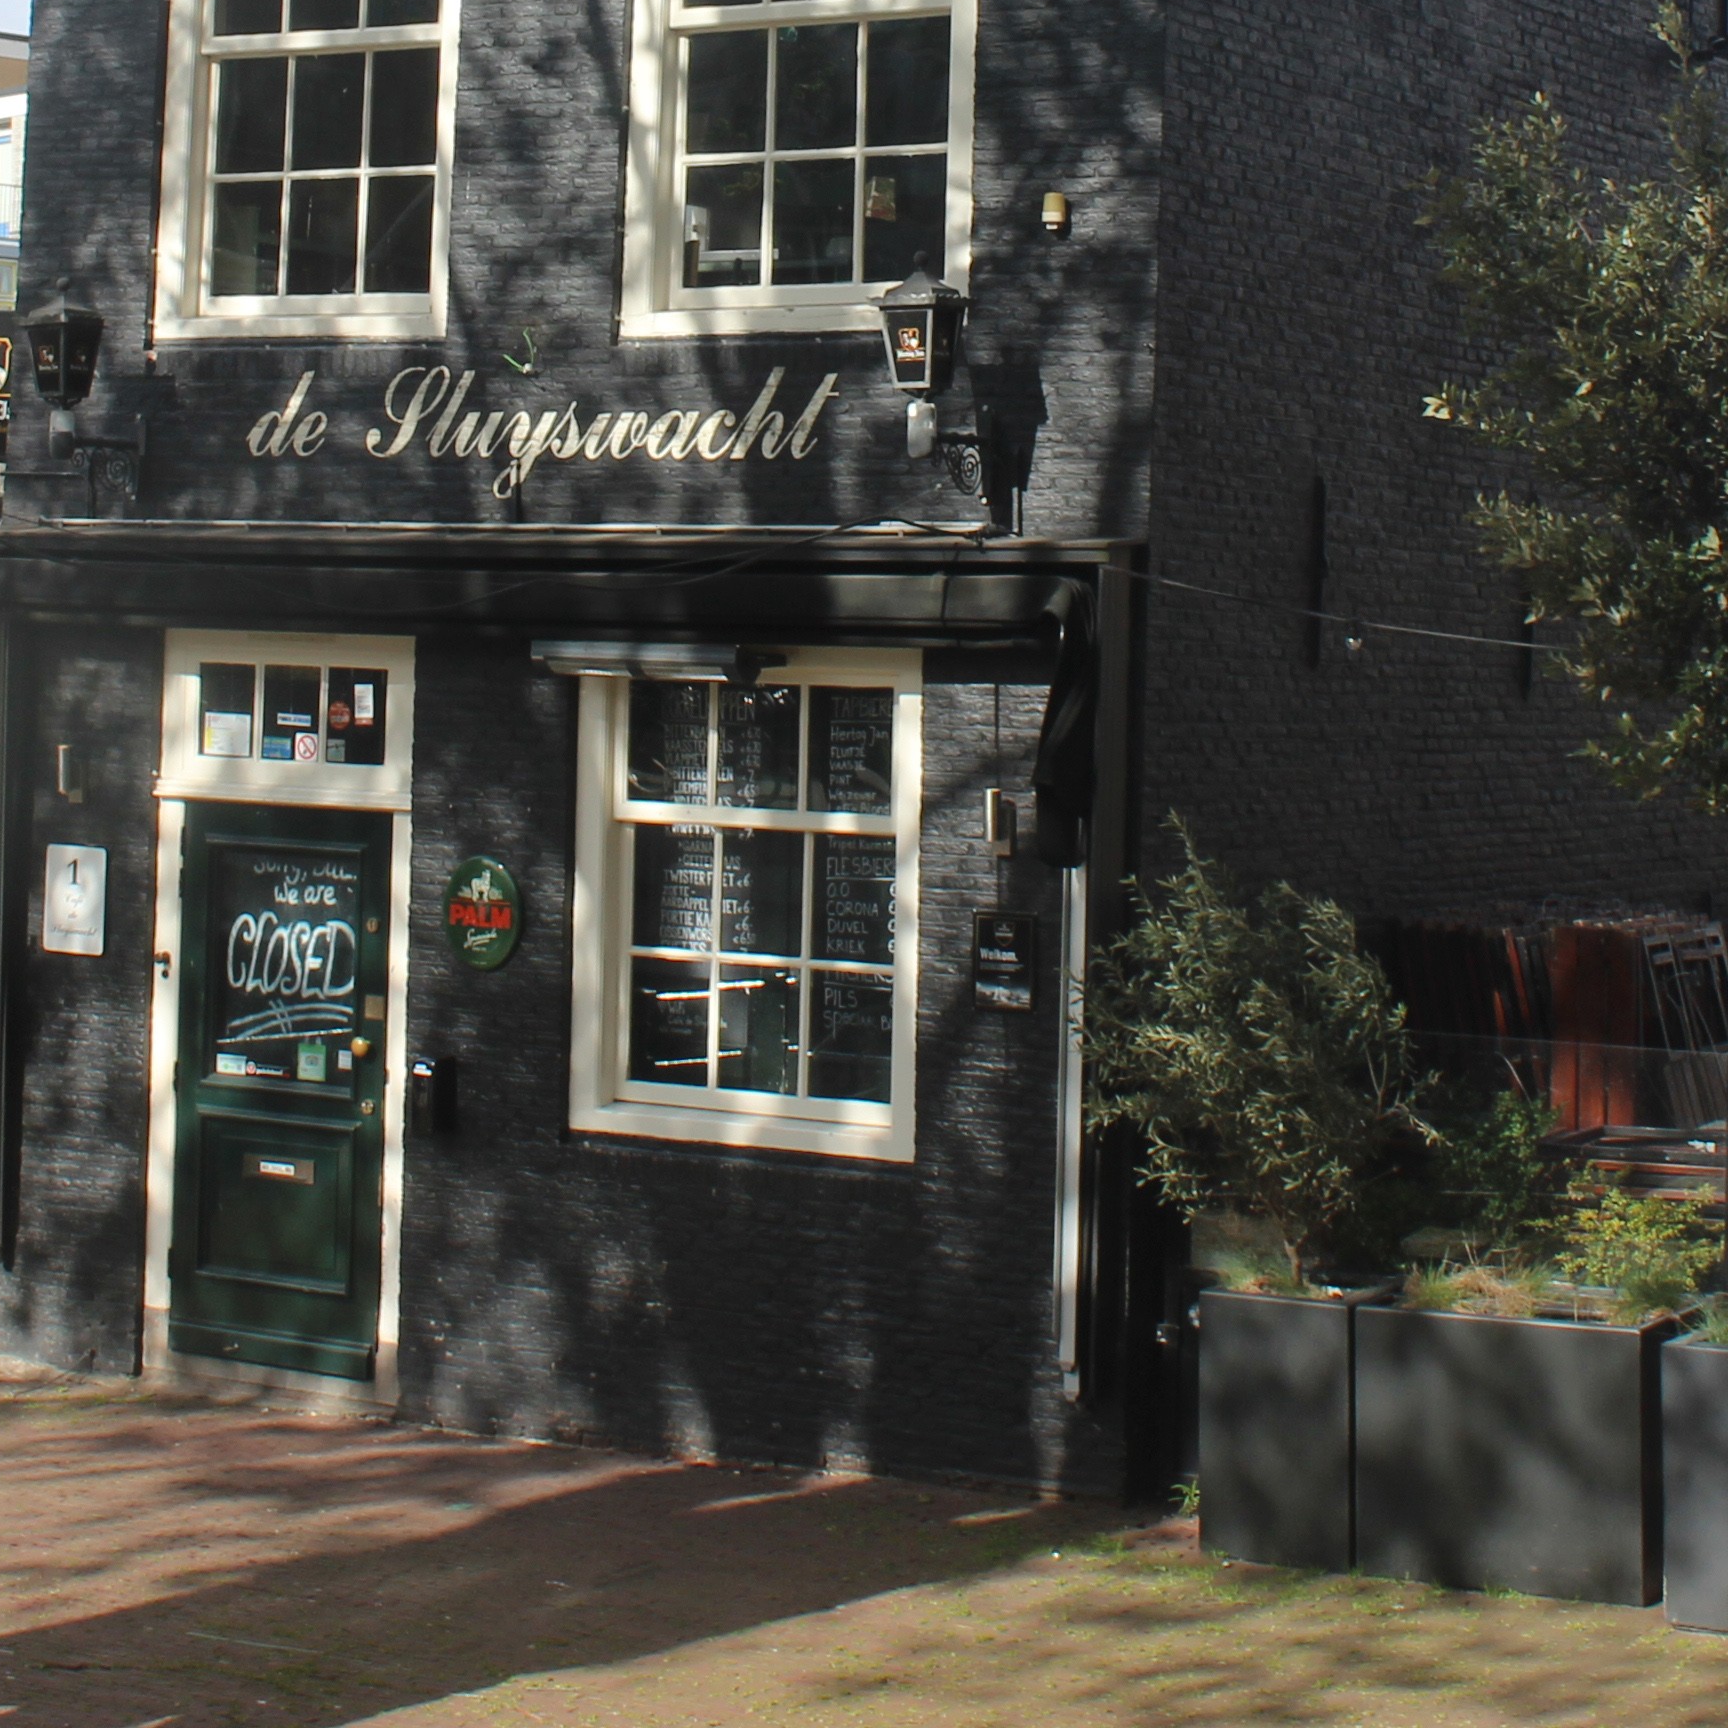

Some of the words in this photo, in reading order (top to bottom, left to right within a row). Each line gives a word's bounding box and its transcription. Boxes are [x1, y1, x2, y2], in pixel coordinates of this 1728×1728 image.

[246, 370, 329, 458] de
[366, 365, 840, 500] Sluyswacht
[68, 858, 78, 885] 1
[304, 885, 338, 906] are
[449, 902, 512, 929] PALM
[826, 900, 879, 917] CORONA
[827, 918, 869, 934] DUVEL
[227, 911, 356, 999] CLOSED
[827, 936, 866, 954] KRIEK
[824, 987, 858, 1008] PILS
